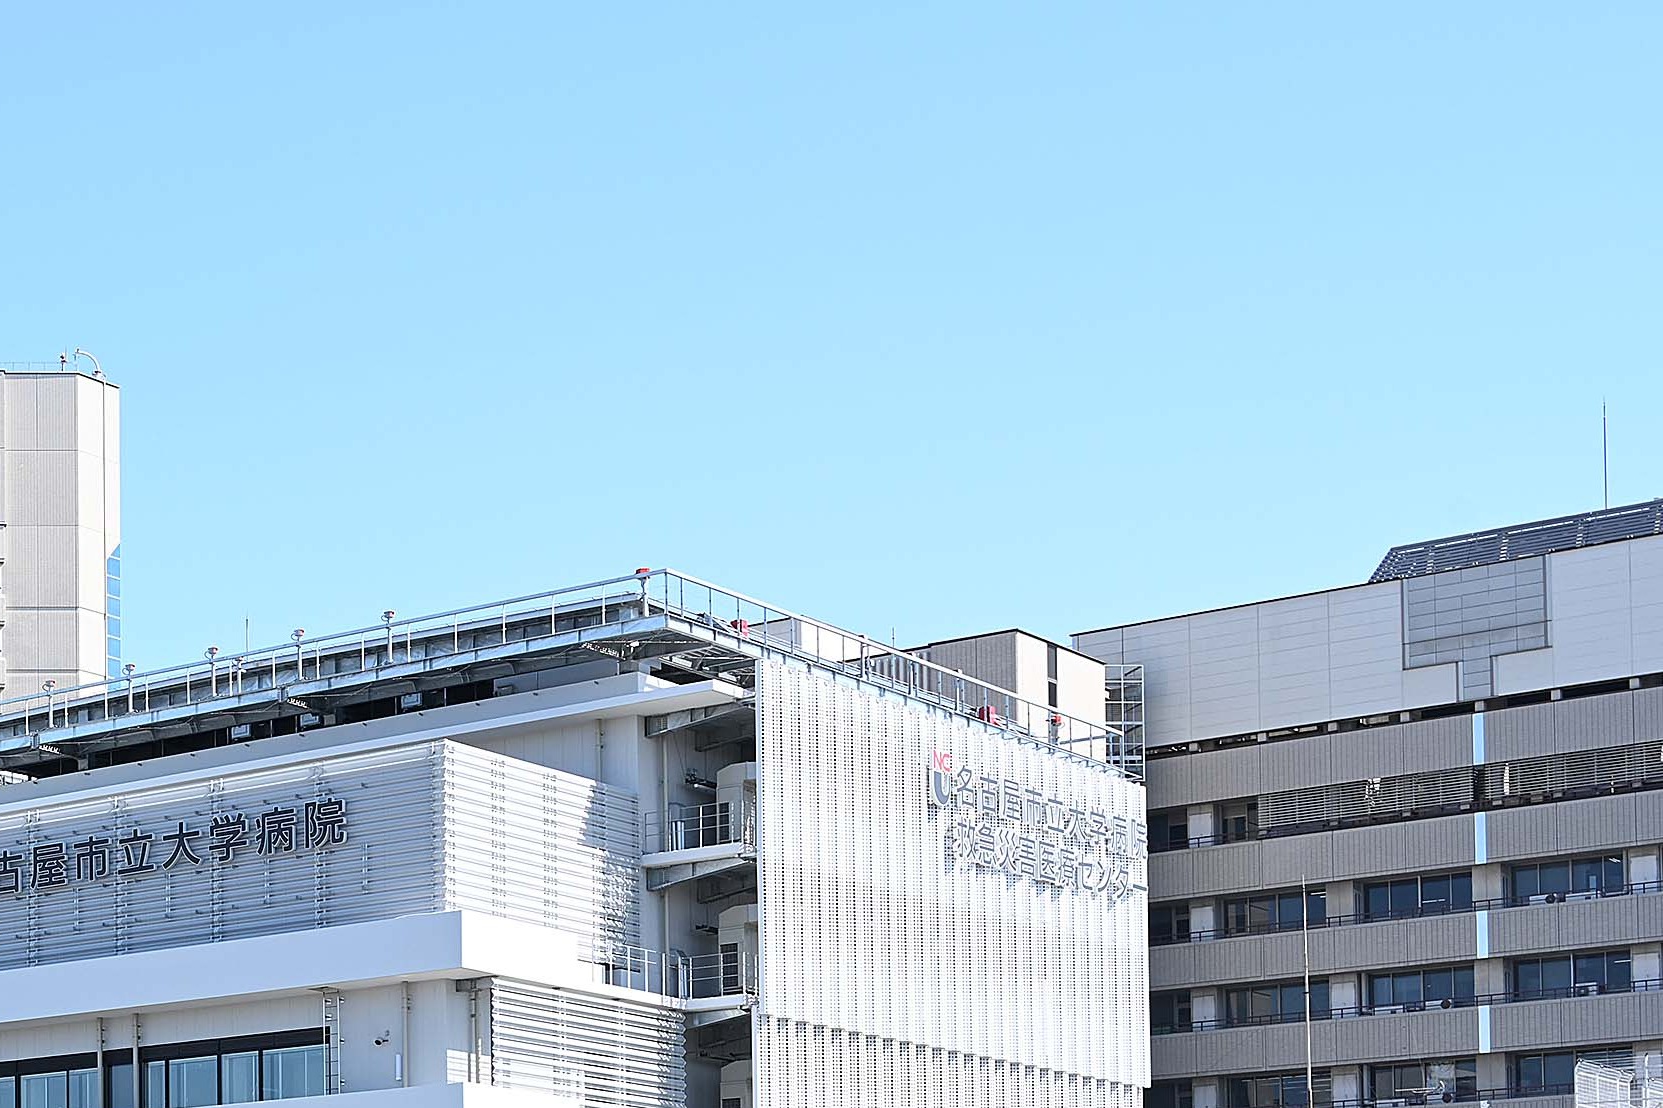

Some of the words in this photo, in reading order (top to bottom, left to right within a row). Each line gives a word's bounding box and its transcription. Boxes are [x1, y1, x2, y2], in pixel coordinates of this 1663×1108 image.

[956, 766, 1147, 859] 名古屋市立大学病院
[956, 818, 1147, 899] 救急災害医療センター
